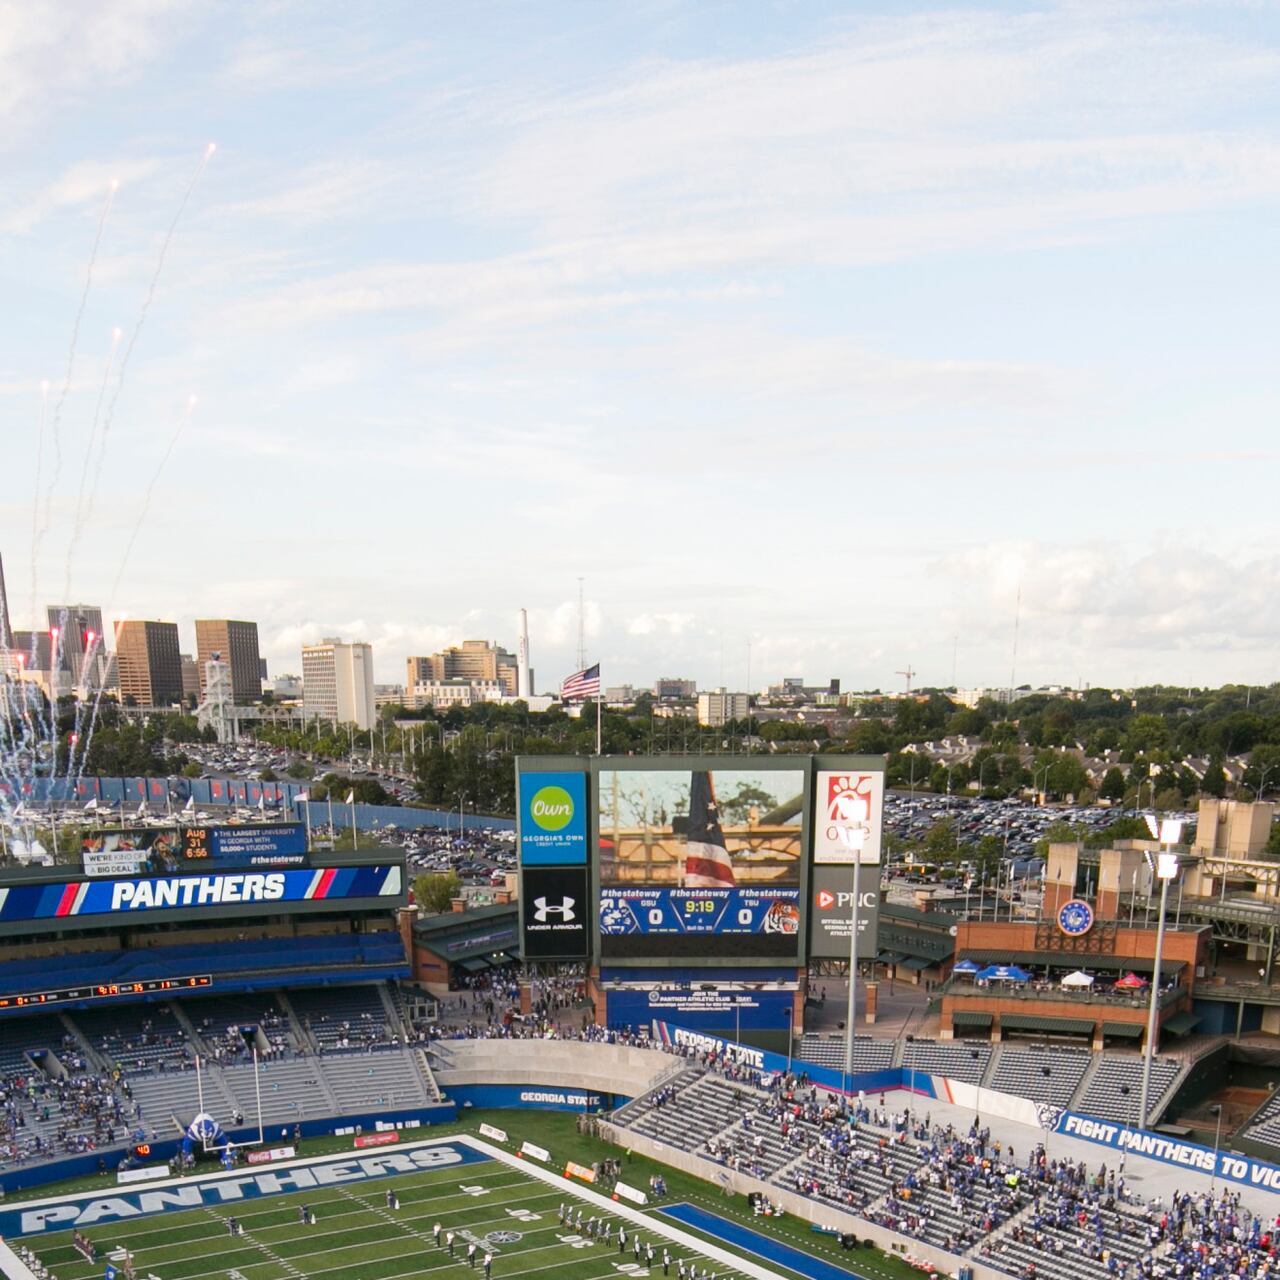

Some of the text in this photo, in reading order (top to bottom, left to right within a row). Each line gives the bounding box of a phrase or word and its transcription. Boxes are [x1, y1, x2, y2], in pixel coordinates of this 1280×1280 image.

[533, 800, 571, 816] Own
[186, 829, 206, 839] Aug
[220, 828, 296, 838] THE LARGEST UNIVERSITY
[190, 838, 201, 847] 31
[226, 837, 253, 845] GEORGIA
[254, 836, 271, 844] WITH
[245, 843, 277, 852] STUDENTS
[88, 854, 113, 862] WE'RE
[113, 853, 132, 861] KIND
[250, 855, 305, 866] #thestateway
[111, 865, 132, 873] DEAL
[111, 873, 286, 910] PANTHERS
[601, 889, 799, 899] #thestateway #thestateway #thestateway
[685, 901, 715, 913] 9:19
[648, 909, 663, 925] 0
[738, 909, 753, 925] 0
[99, 985, 118, 994] 9:19
[674, 1028, 724, 1054] GEORGIA
[520, 1091, 601, 1107] GEORGIA STATE
[137, 1144, 151, 1155] 40
[1065, 1115, 1119, 1144] FIGHT
[1118, 1130, 1217, 1172] PANTHERS
[1222, 1157, 1248, 1180] TO
[20, 1145, 464, 1235] PANTHERS
